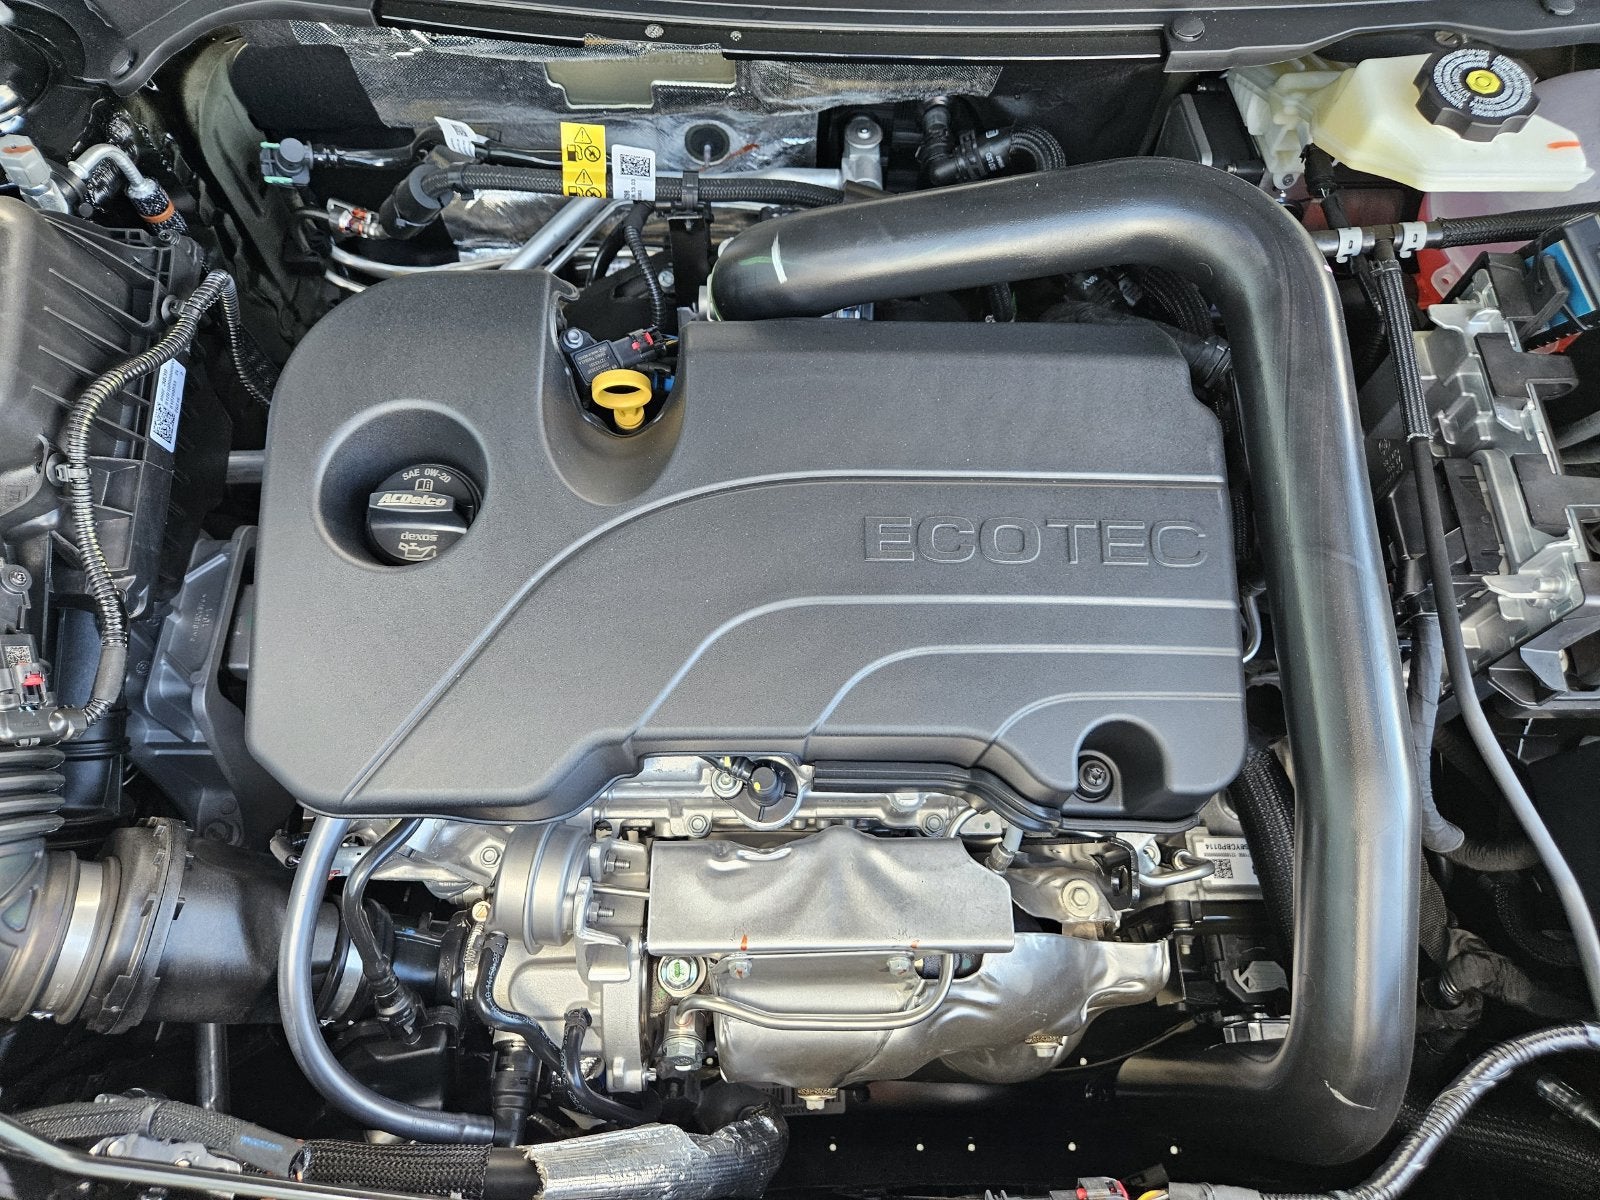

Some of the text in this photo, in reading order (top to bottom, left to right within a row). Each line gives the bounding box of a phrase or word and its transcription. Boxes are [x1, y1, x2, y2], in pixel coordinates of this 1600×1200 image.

[402, 467, 452, 483] SAE 0W-20
[377, 493, 448, 507] ACDelco
[401, 531, 438, 541] dexos
[864, 516, 1208, 568] ECOTEC
